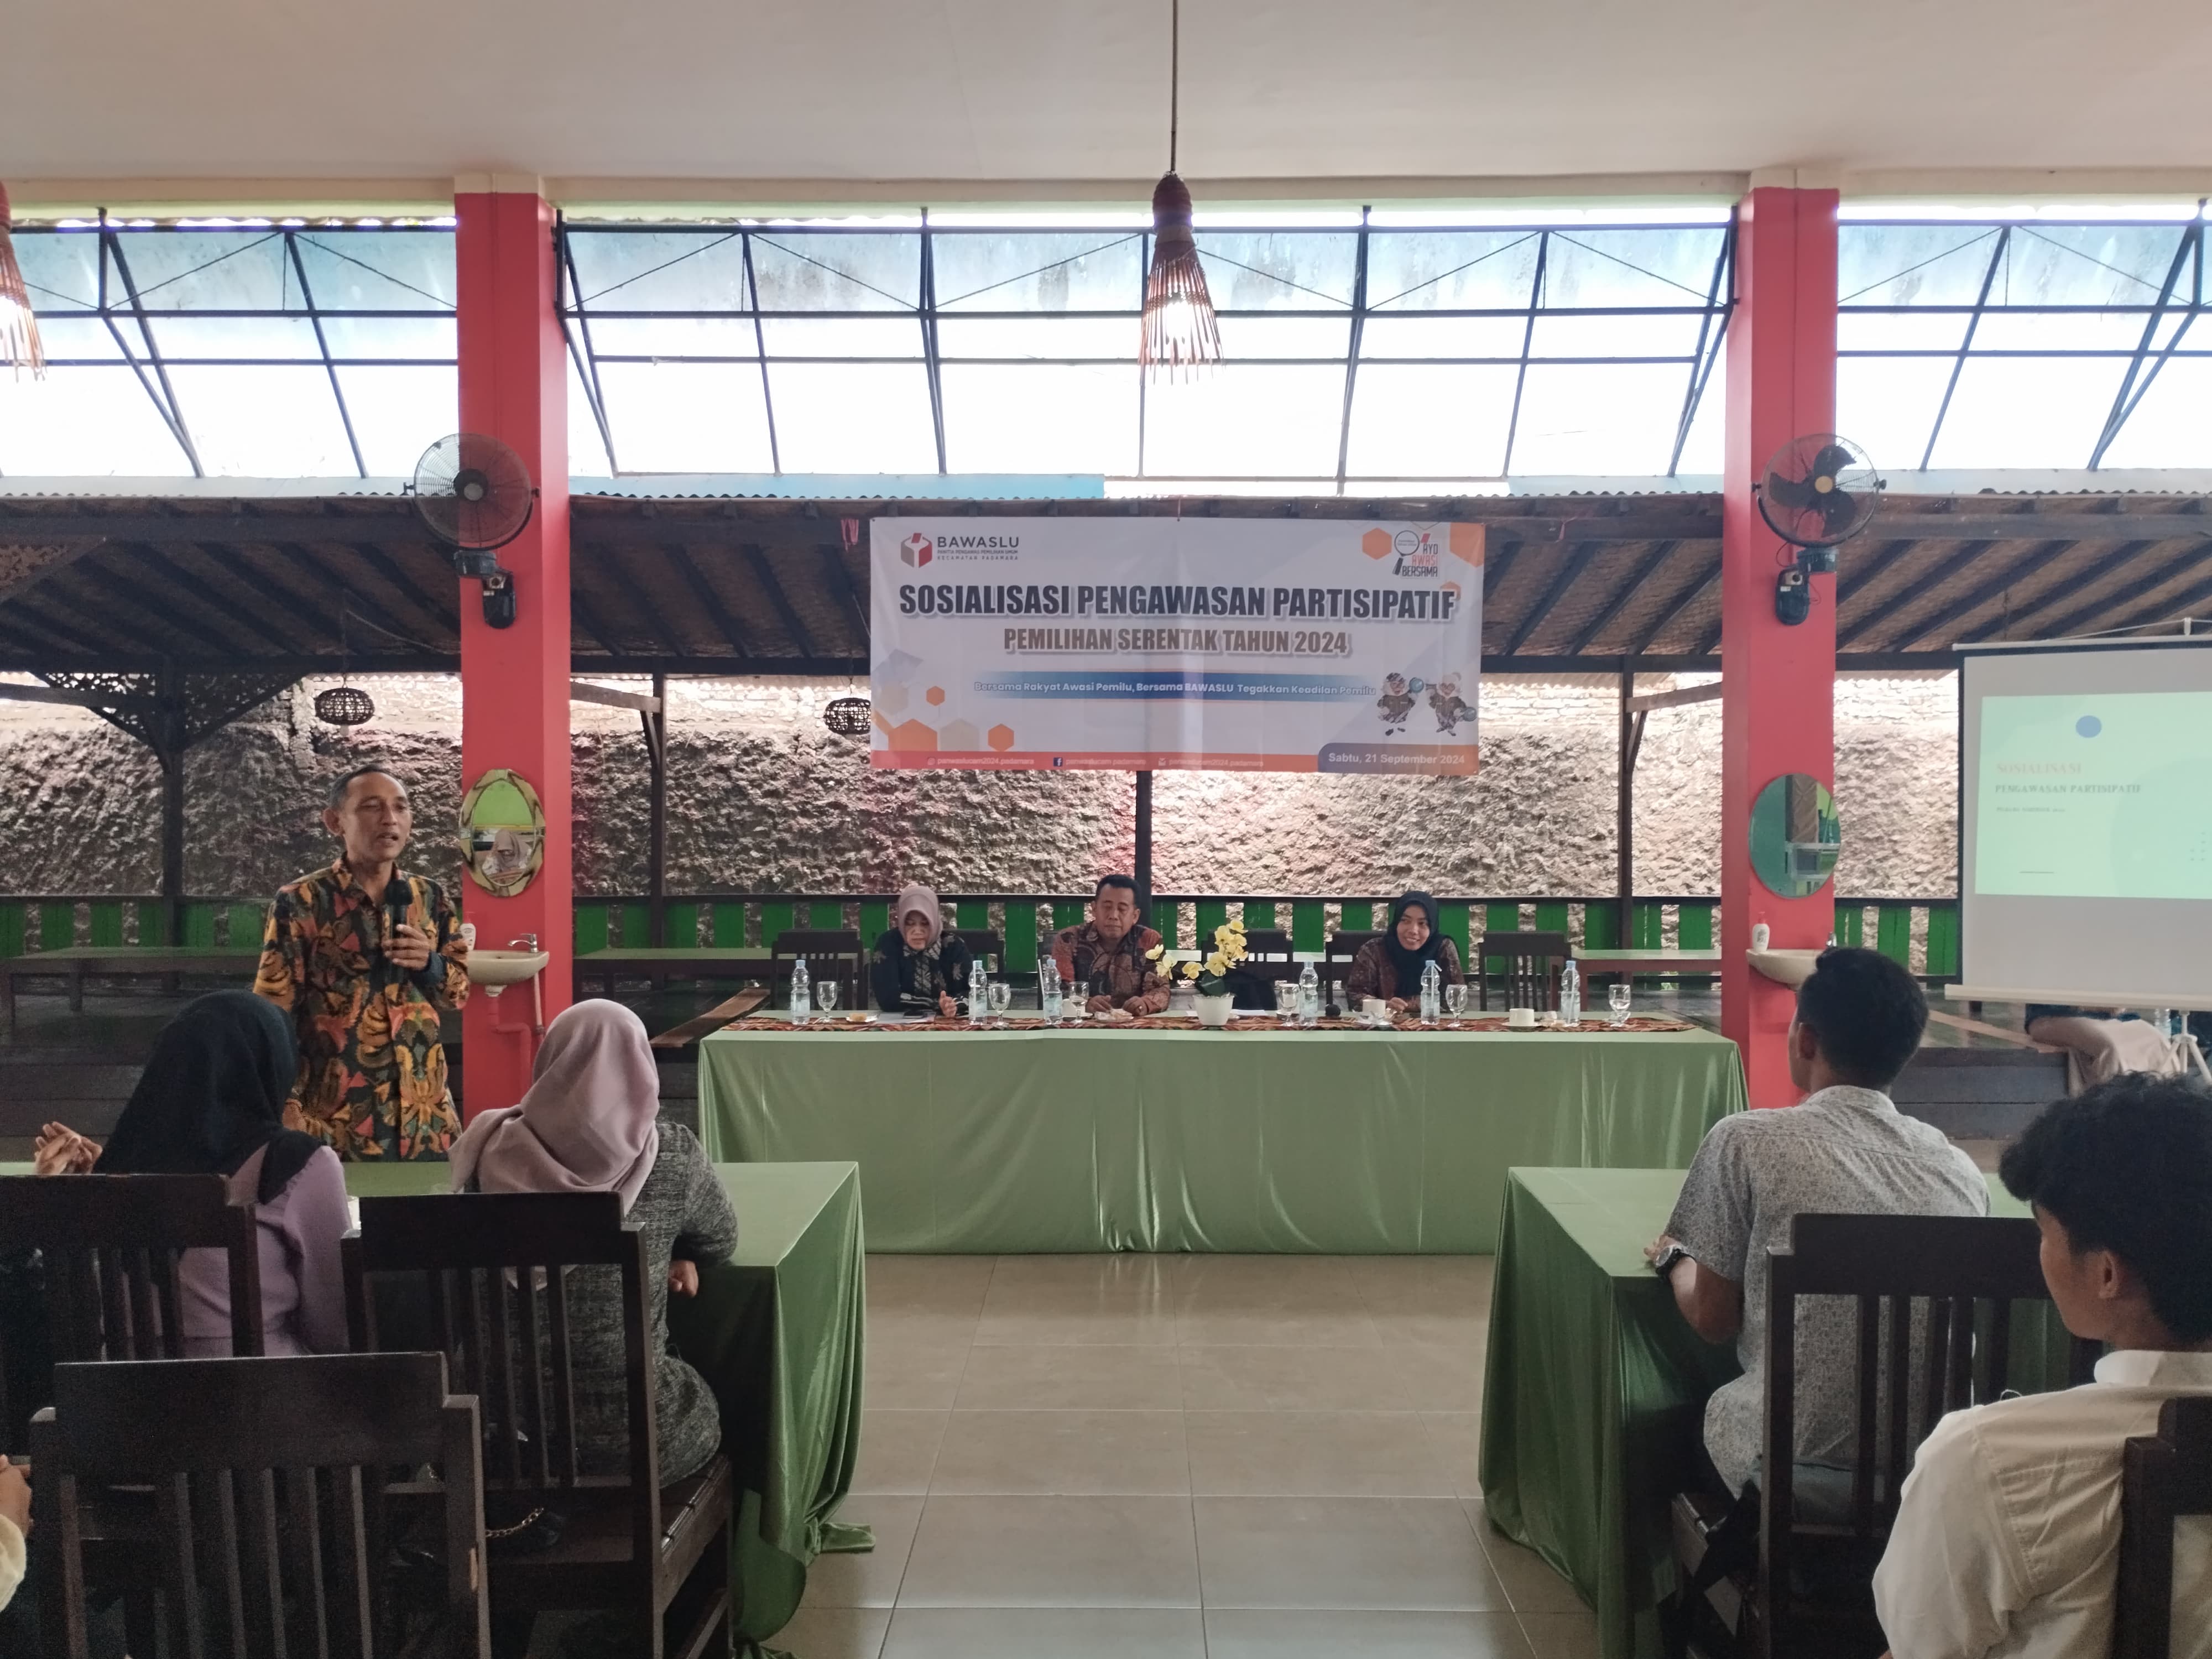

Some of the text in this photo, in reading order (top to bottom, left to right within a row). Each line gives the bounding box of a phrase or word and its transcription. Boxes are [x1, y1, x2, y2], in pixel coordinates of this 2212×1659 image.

[937, 536, 1020, 548] BAWASLU
[1423, 544, 1438, 555] AYO
[1412, 555, 1438, 566] AWASI
[1402, 566, 1438, 577] BERSAMA
[899, 585, 1455, 619] SOSIALISASI PENGAWASAN PARTISIPATIF
[1004, 628, 1348, 654] PEMILIHAN SERENTAK TAHUN 2024
[974, 682, 1376, 696] Bersama Rakyat Awasi Pemilu, Bersama BAWASLU Tegakkan Keadilan Pemilu
[1328, 753, 1465, 765] Sabtu, 21 September 2024
[1996, 763, 2083, 775] SOSIALISASI
[1995, 784, 2142, 794] PENGAWASAN PARTISIPATIF
